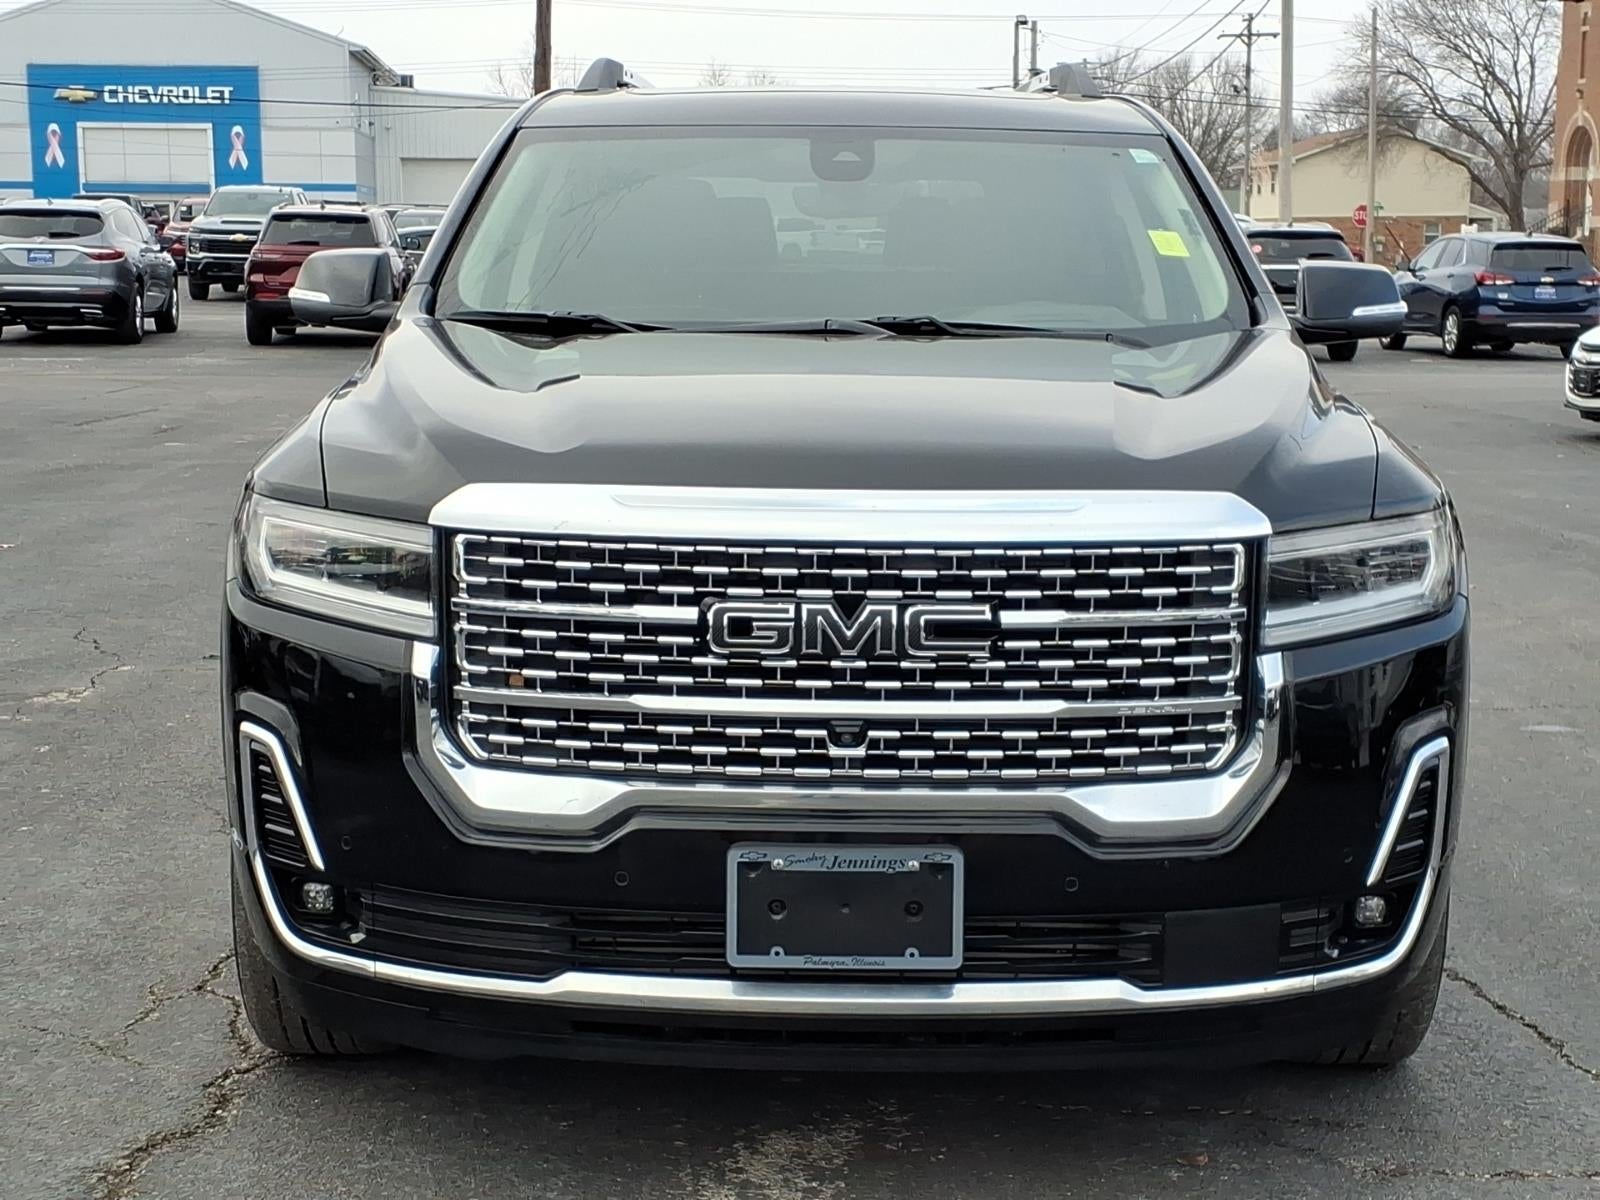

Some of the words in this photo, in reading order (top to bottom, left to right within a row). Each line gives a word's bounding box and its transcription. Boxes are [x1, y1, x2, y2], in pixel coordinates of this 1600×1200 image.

[103, 85, 233, 104] CHEVROLET
[708, 602, 992, 656] GMC
[826, 854, 907, 872] Jennings
[803, 956, 849, 968] Palmyra,
[851, 957, 886, 967] Illinois
